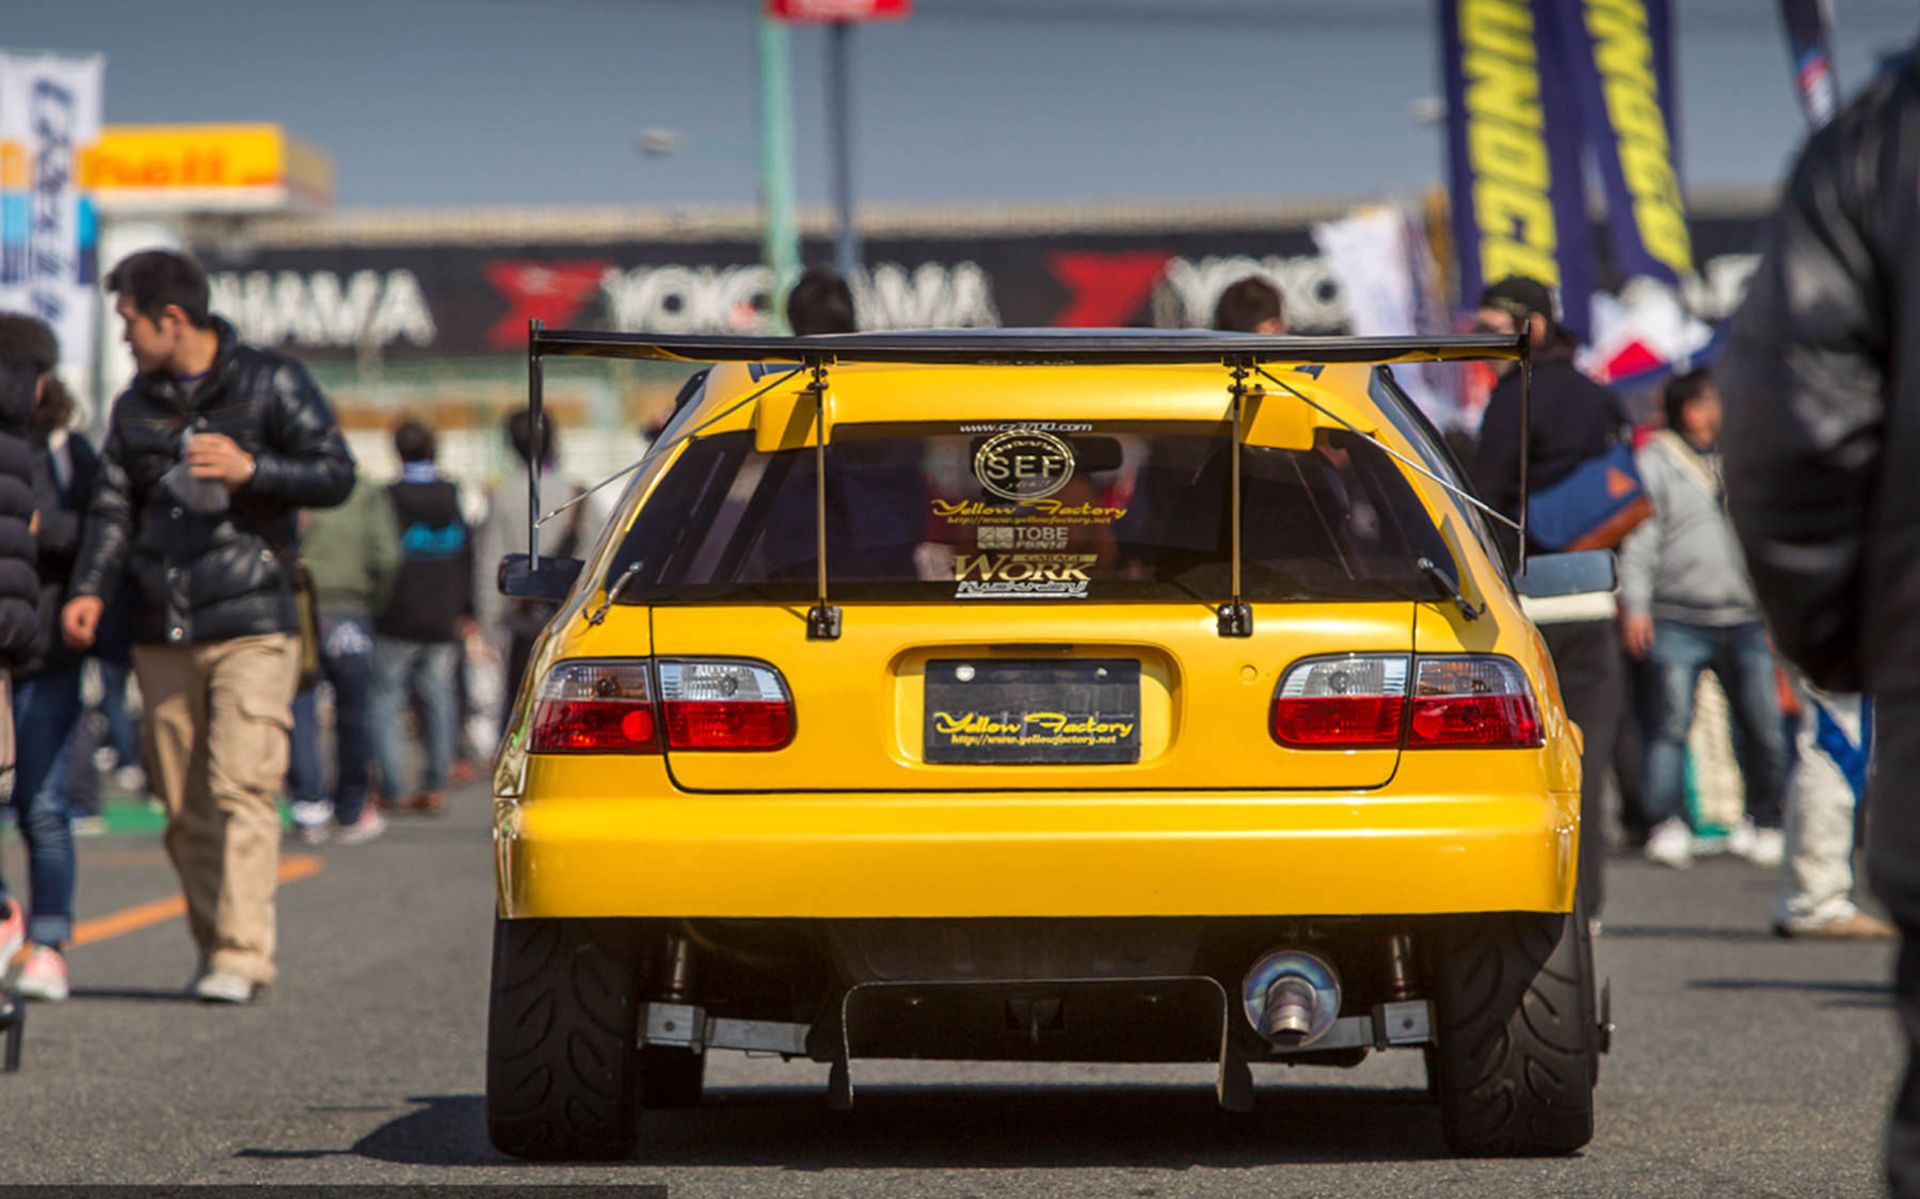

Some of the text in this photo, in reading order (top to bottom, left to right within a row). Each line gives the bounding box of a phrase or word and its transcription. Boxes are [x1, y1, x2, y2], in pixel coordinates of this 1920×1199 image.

[986, 455, 1064, 480] SEF
[930, 498, 1129, 519] Yellow Factory
[1015, 527, 1069, 541] TOBE
[933, 711, 1135, 738] Yellow Factory
[950, 733, 1118, 747] http://www.yellowfactory.net
